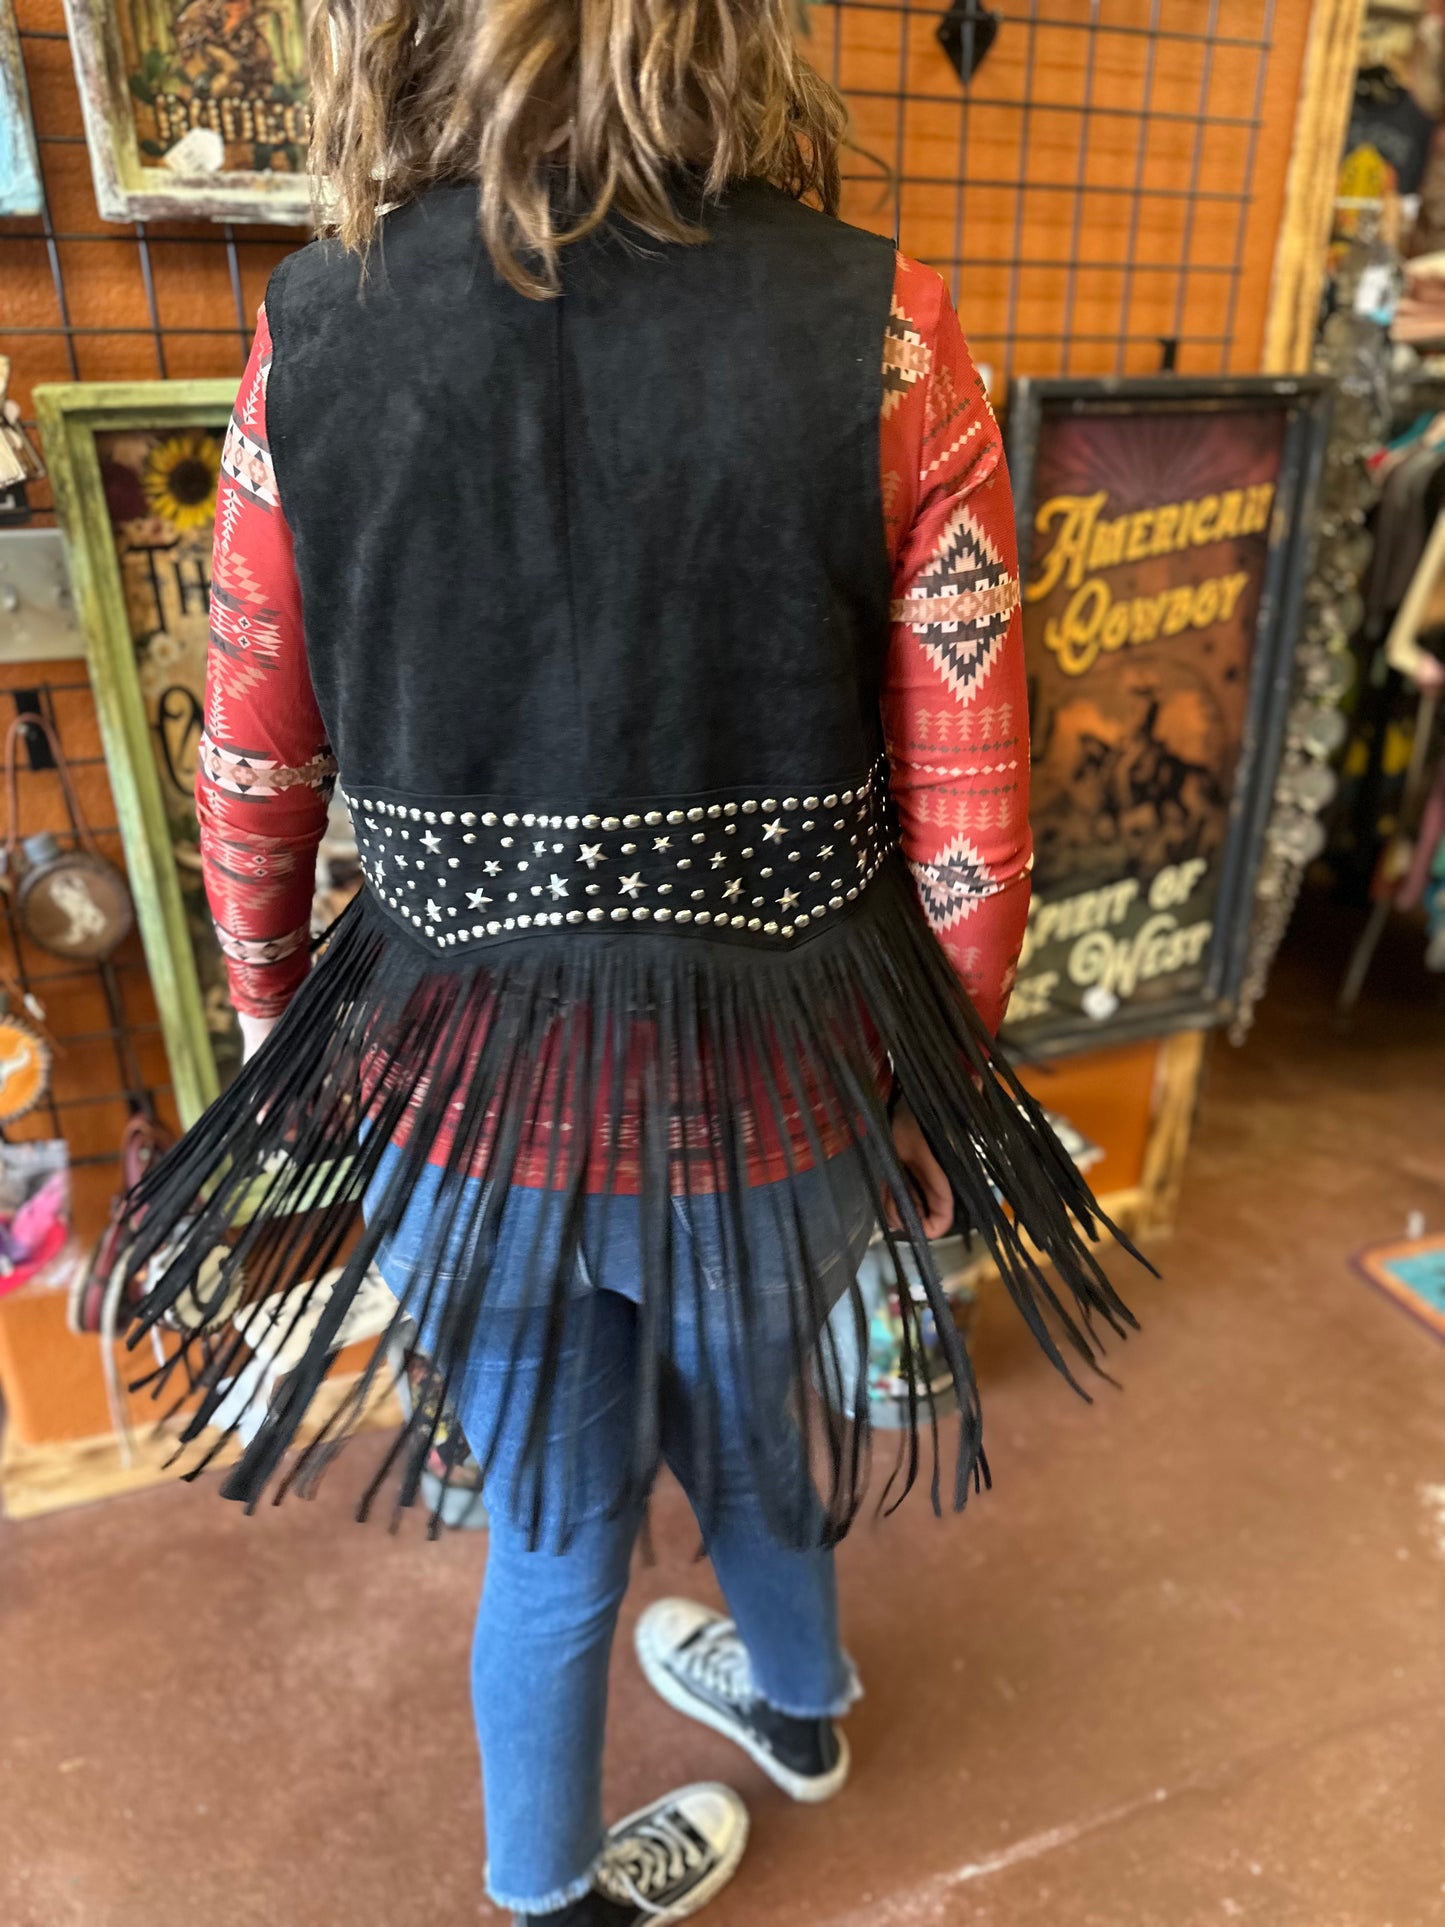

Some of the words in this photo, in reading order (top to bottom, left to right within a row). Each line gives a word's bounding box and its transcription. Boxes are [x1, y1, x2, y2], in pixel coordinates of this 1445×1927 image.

[126, 535, 212, 632] TH
[1024, 483, 1275, 602] AMERICAN
[1044, 571, 1248, 676] COWBOY
[1148, 856, 1208, 910] OF
[1066, 911, 1213, 998] WEST
